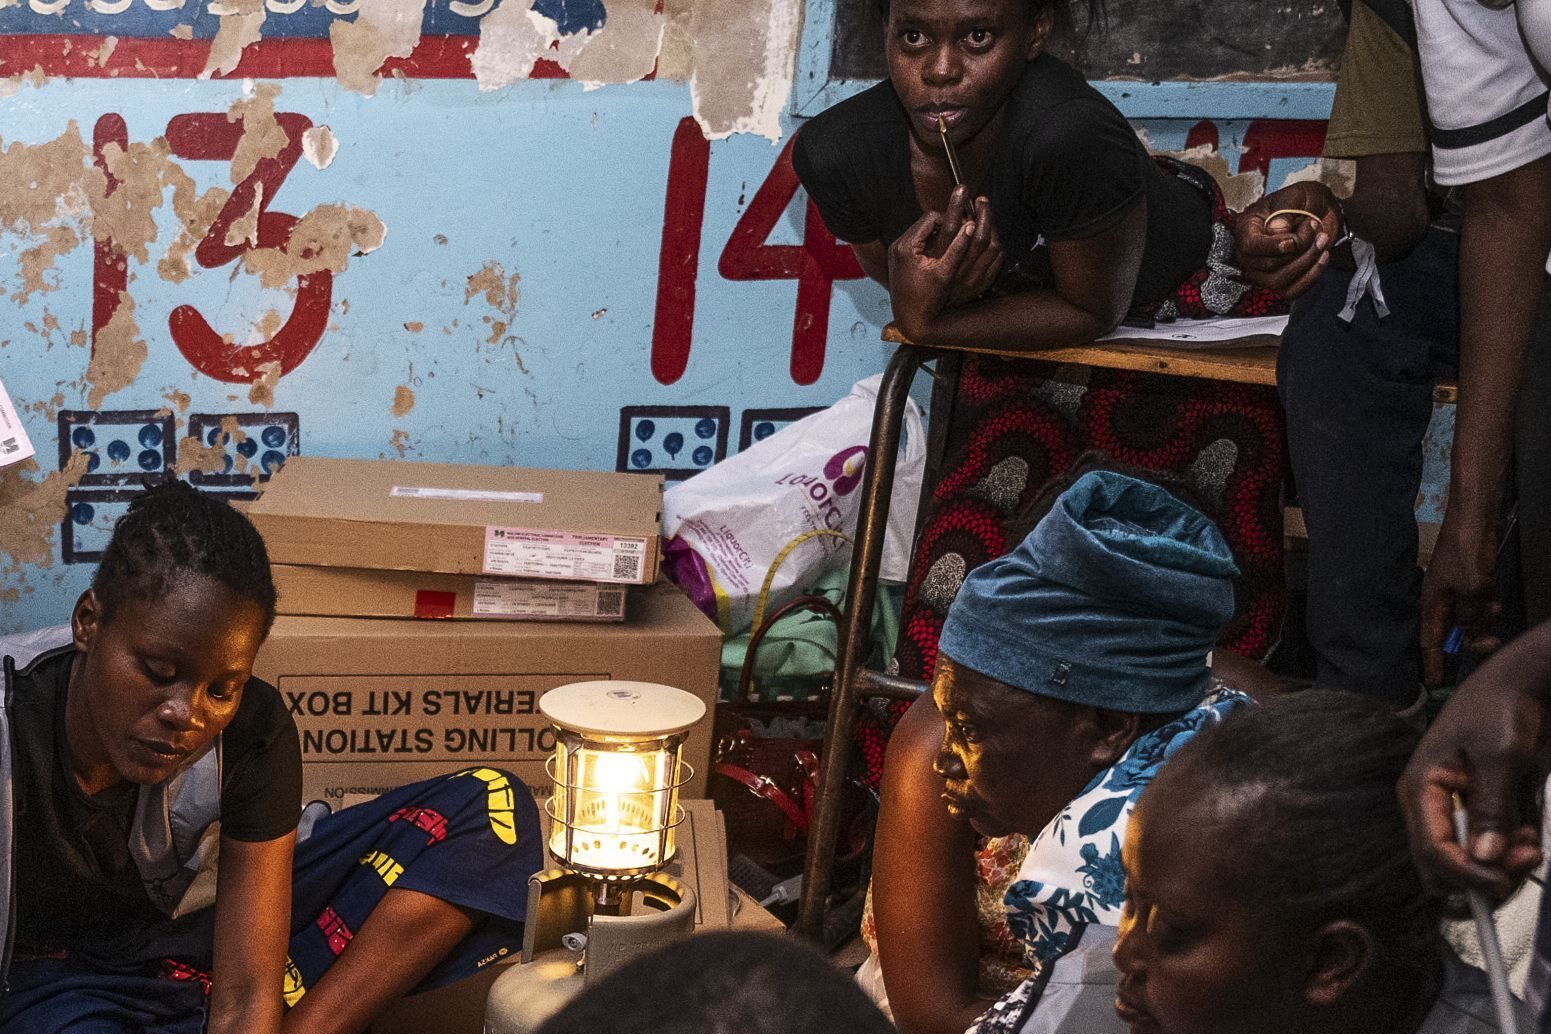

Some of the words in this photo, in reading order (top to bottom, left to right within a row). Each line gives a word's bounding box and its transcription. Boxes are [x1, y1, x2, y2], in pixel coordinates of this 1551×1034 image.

[92, 112, 333, 384] 13
[651, 115, 867, 386] 14
[286, 691, 352, 716] BOX
[362, 691, 411, 716] KIT
[303, 728, 433, 754] STATION
[444, 728, 558, 753] OLLING
